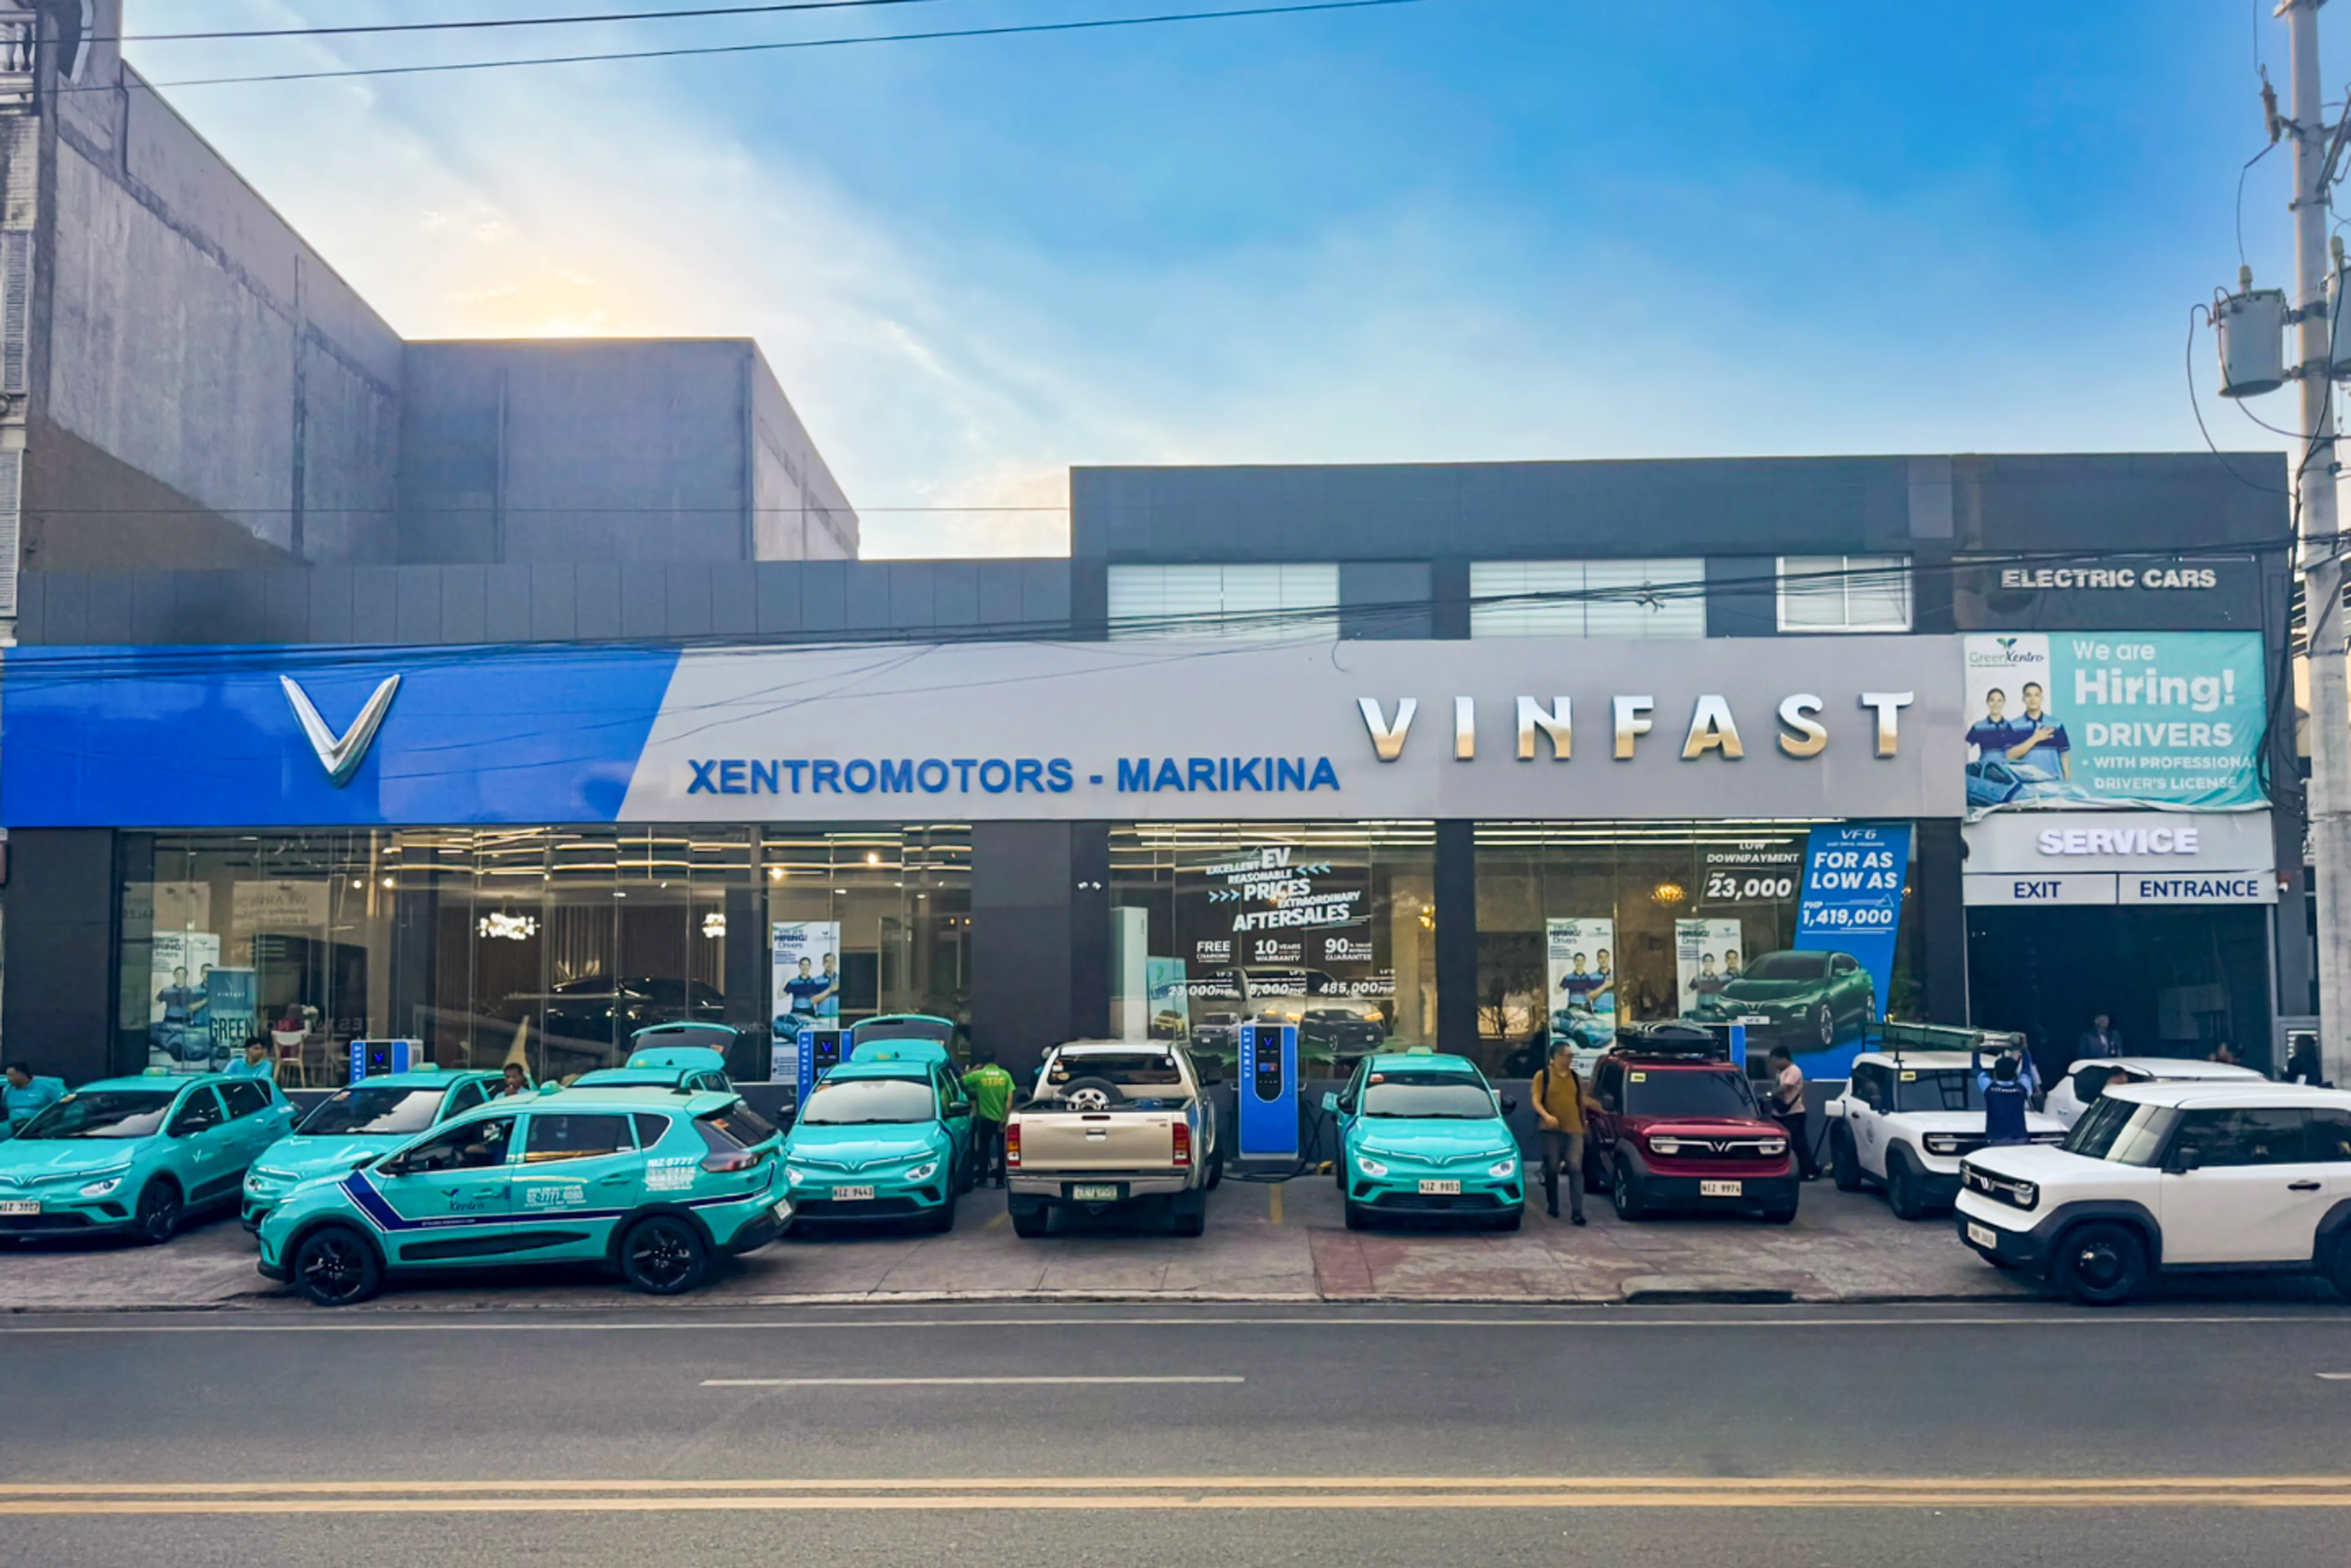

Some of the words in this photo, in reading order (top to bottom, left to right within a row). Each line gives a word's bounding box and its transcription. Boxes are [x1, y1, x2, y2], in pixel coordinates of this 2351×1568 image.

[2000, 568, 2135, 590] ELECTRIC
[2142, 568, 2218, 590] CARS
[2072, 640, 2110, 661] We
[2116, 643, 2156, 661] are
[2074, 667, 2236, 713] Hiring!
[1357, 692, 1915, 763] VINFAST
[2085, 722, 2233, 748] DRIVERS
[2094, 756, 2137, 770] WITH
[687, 758, 1074, 795] XENTROMOTORS
[1117, 756, 1340, 792] MARIKINA
[2094, 777, 2167, 790] DRIVER'S
[2171, 776, 2237, 790] LICENSE
[2037, 828, 2199, 856] SERVICE
[1261, 847, 1291, 869] EV
[1707, 853, 1799, 864] DOWNPAYMENT
[1813, 852, 1857, 869] FOR
[1862, 852, 1894, 869] AS
[1206, 861, 1260, 875] EXCELLENT
[1228, 869, 1292, 884] REASONABLE
[1243, 878, 1311, 901] PRICES
[1707, 878, 1792, 901] 23,000
[1810, 872, 1863, 890] LOW
[1867, 872, 1898, 889] AS
[2140, 880, 2259, 898] ENTRANCE
[1277, 890, 1361, 909] EXTRAORDINARY
[2014, 882, 2061, 899] EXIT
[1232, 904, 1349, 932] AFTERSALES
[1802, 909, 1893, 928] 1,419,000
[1196, 940, 1231, 953] FREE
[1255, 939, 1278, 955] 10
[1325, 937, 1348, 954] 90
[1319, 982, 1378, 996] 485,000
